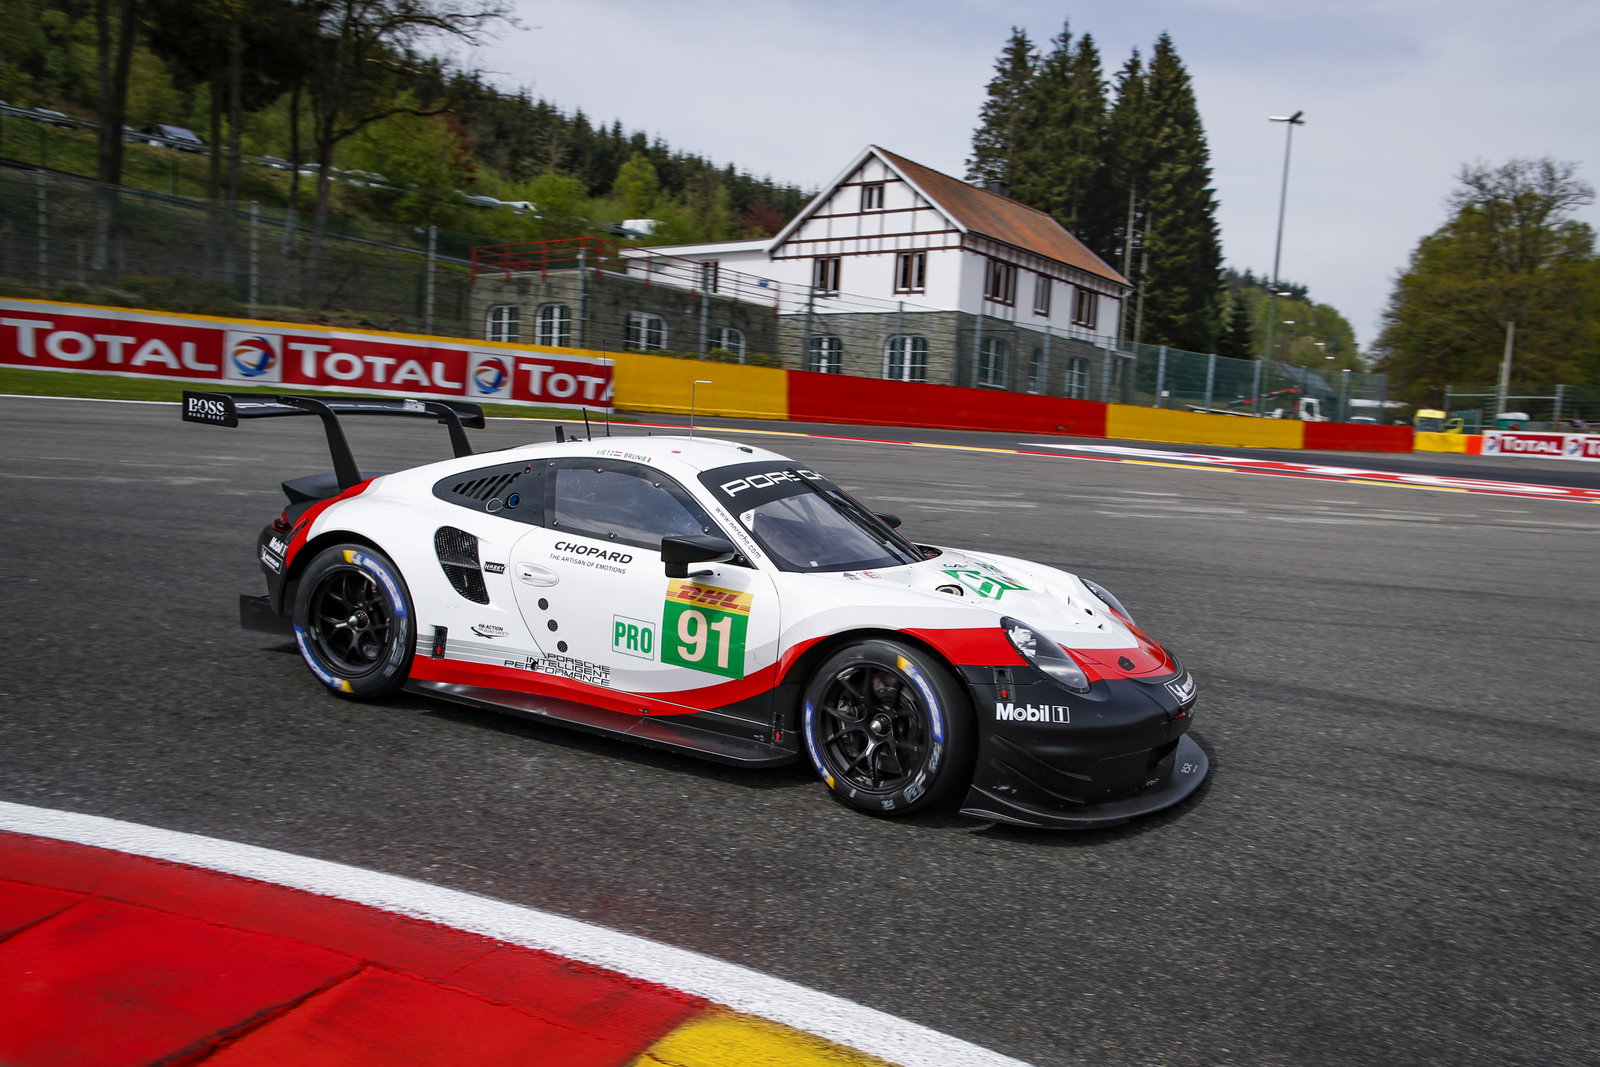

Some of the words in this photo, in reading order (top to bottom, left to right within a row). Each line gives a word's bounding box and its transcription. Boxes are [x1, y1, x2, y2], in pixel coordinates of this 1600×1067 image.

[1, 317, 218, 372] TOTAL
[288, 342, 463, 389] TOTAL
[188, 397, 225, 416] BOSS
[597, 449, 615, 457] LIETZ
[1502, 436, 1563, 454] TOTAL
[554, 541, 633, 563] CHOPARD
[549, 553, 560, 561] THE
[561, 556, 586, 567] ARTISAN
[595, 563, 627, 575] EMOTIONS
[677, 585, 741, 610] DHL
[614, 621, 653, 654] PRO
[677, 609, 733, 669] 91
[526, 656, 611, 679] INTELLIGENT
[547, 652, 611, 673] PORSCHE
[996, 702, 1050, 723] Mobil
